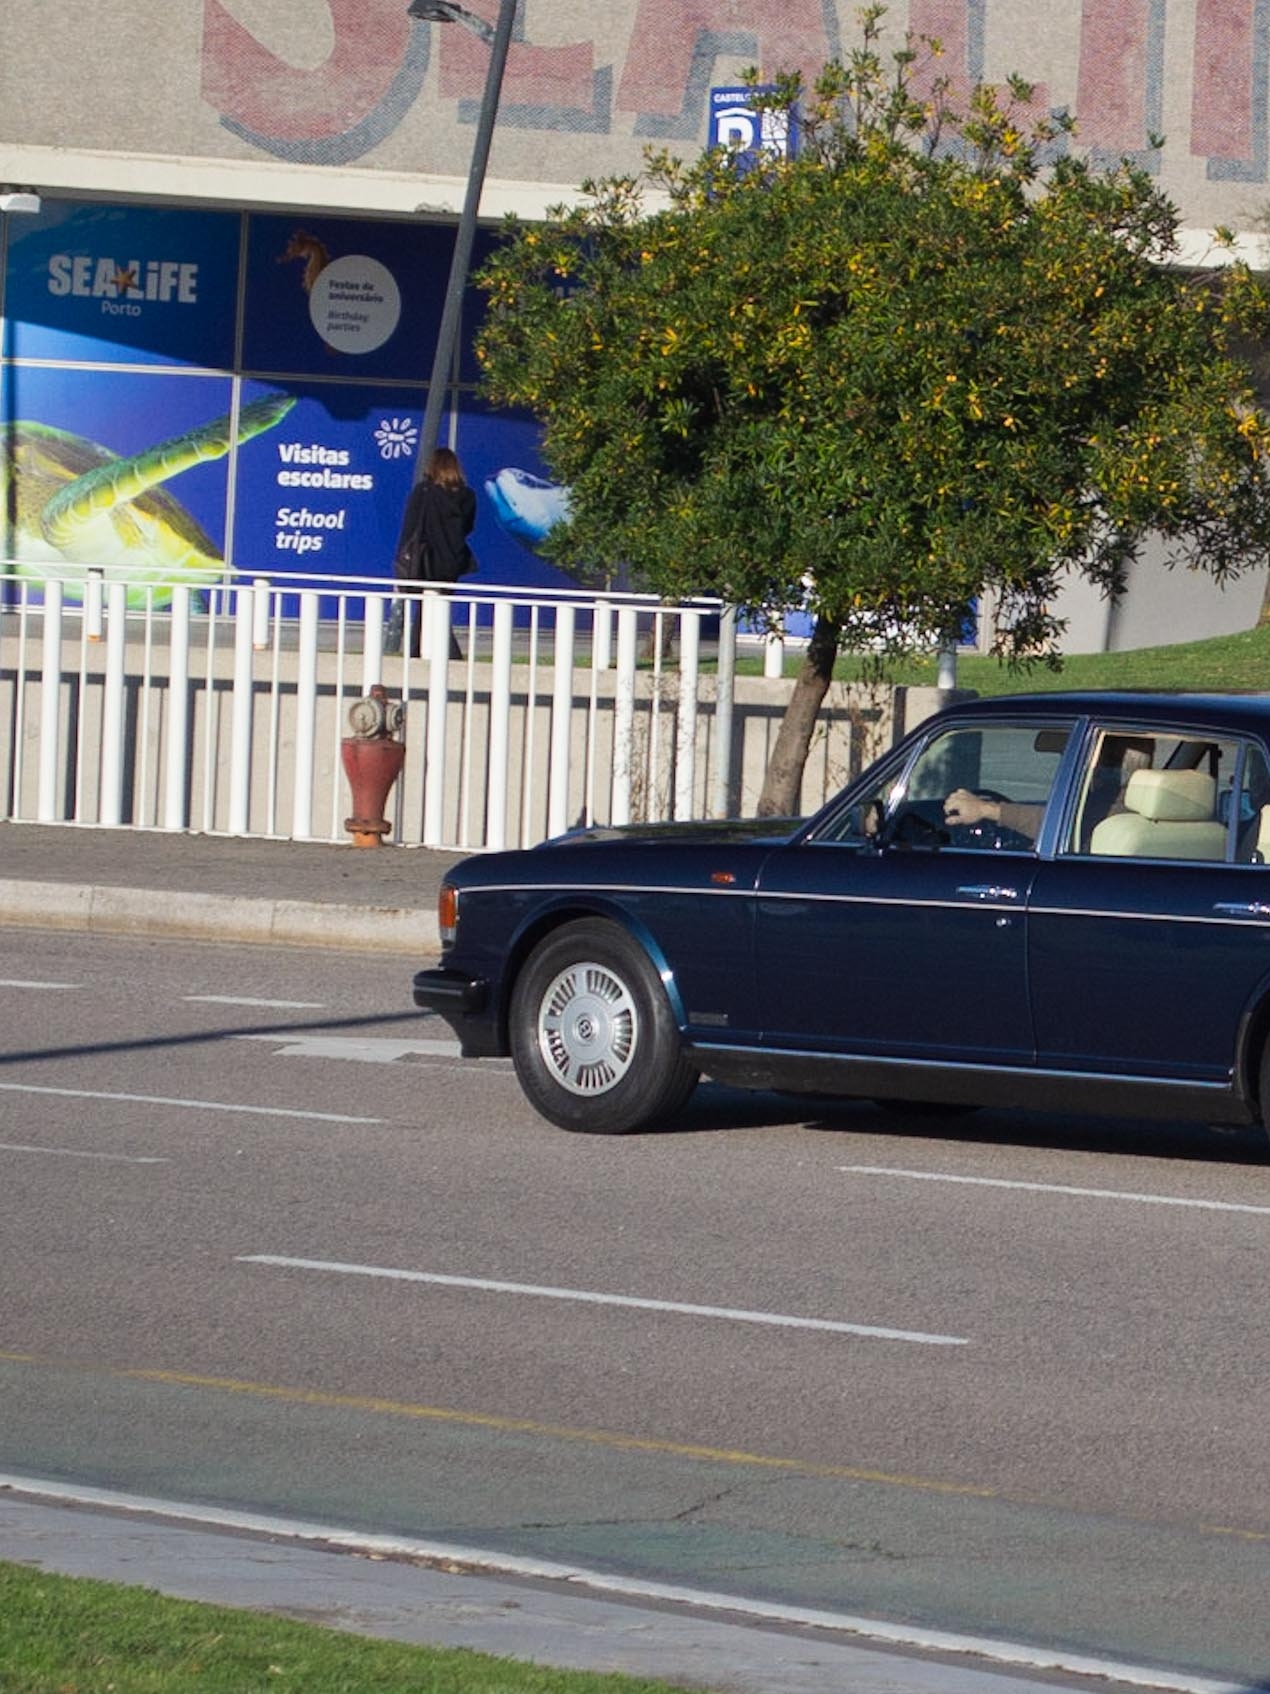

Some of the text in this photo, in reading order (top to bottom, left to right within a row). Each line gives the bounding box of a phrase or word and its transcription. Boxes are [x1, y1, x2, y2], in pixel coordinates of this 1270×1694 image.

[48, 254, 117, 298] SEA
[329, 280, 360, 291] Festas
[101, 301, 142, 317] Porto
[278, 443, 350, 466] Visitas
[277, 468, 374, 490] escolares
[275, 508, 346, 530] School
[275, 530, 323, 554] trips
